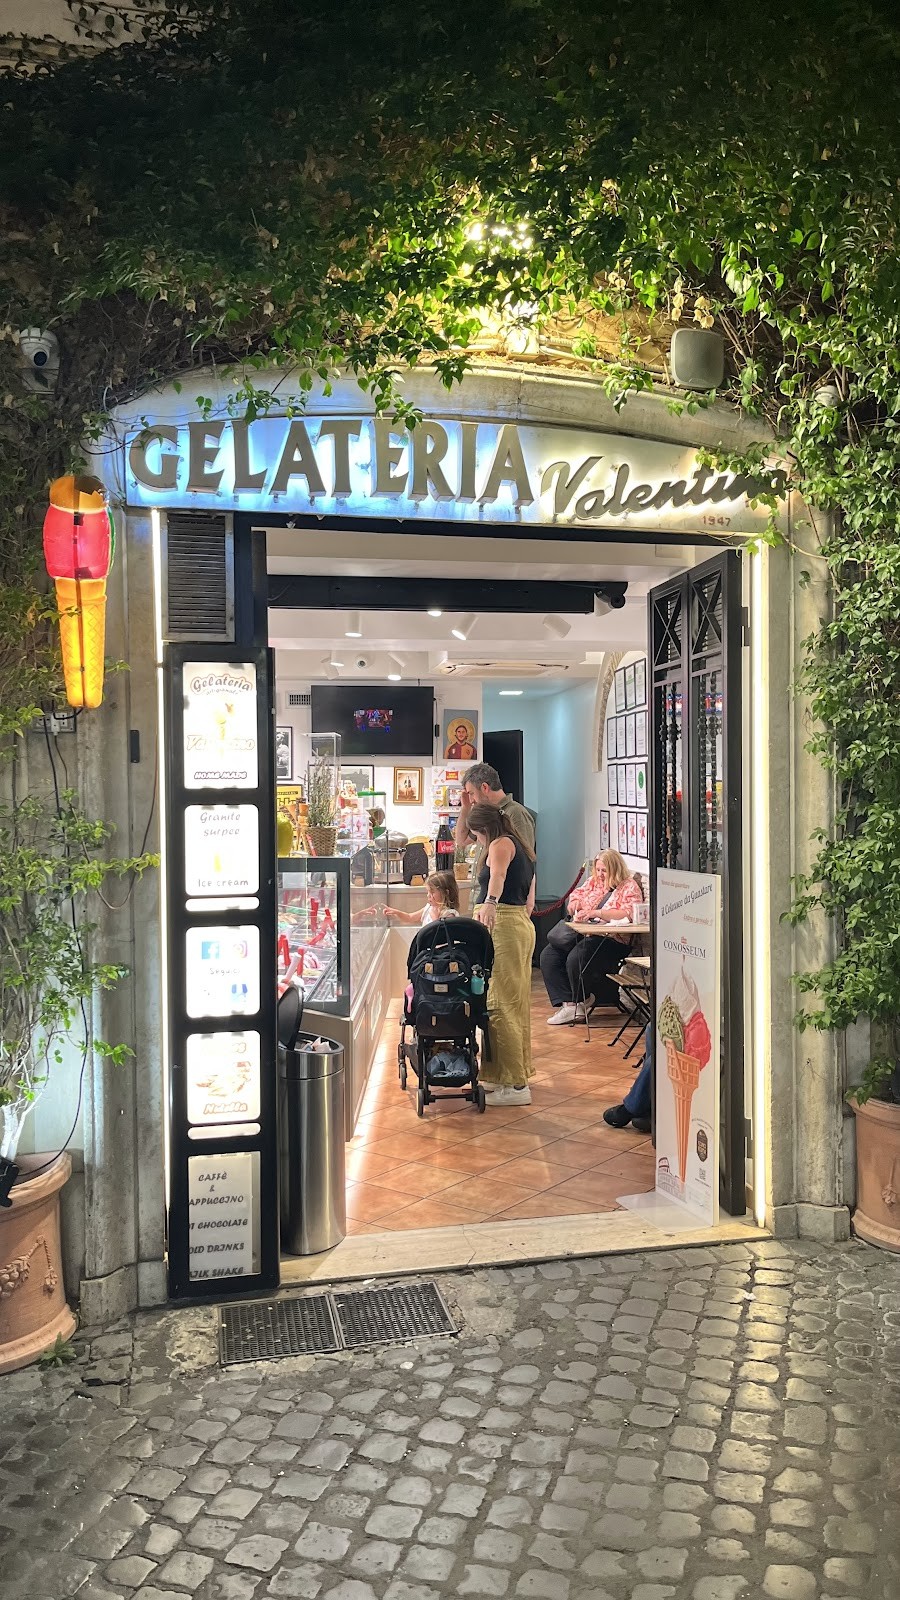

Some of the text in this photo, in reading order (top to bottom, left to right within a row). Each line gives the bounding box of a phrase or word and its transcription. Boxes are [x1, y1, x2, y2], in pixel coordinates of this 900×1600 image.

[128, 419, 535, 507] GELATERIA
[702, 515, 732, 527] 1947
[193, 676, 250, 692] Gelateria
[216, 879, 249, 887] cream
[663, 939, 706, 958] CONOSSEUM
[197, 1218, 249, 1230] CHOCOLATE
[206, 1242, 245, 1253] DRINKS
[211, 1266, 244, 1277] SHAKE
